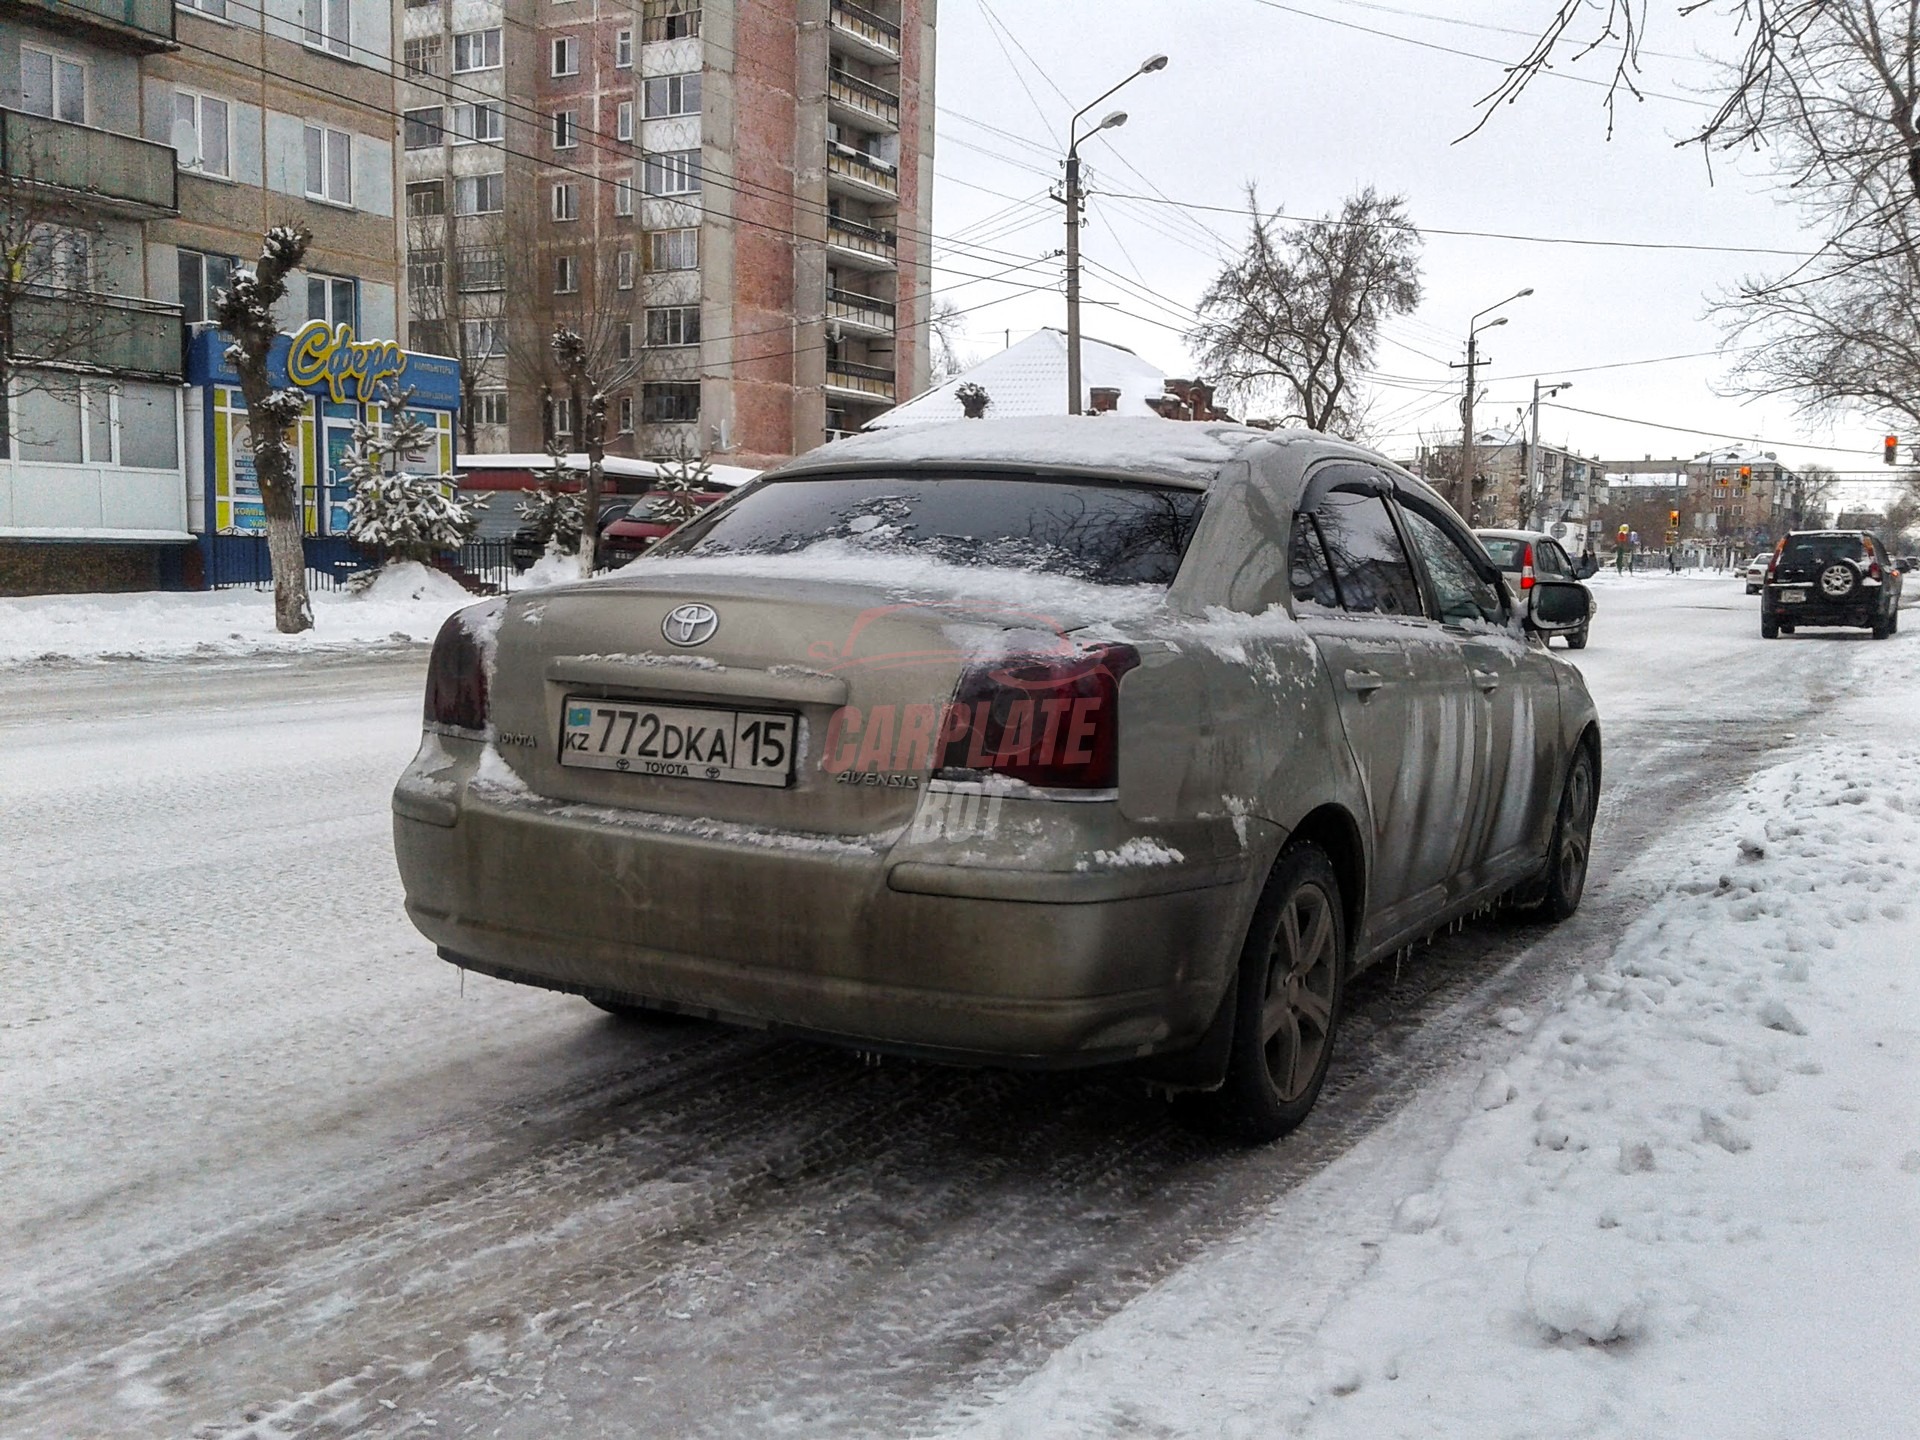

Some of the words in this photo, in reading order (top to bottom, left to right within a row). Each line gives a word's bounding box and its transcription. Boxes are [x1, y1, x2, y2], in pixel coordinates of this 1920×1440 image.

[288, 321, 407, 404] Сфера
[234, 507, 266, 516] КОМПЬ
[565, 732, 590, 751] KZ
[597, 709, 729, 764] 772DKA
[741, 720, 787, 768] 15
[645, 761, 689, 776] TOYOTA
[836, 770, 919, 789] AVENSIS
